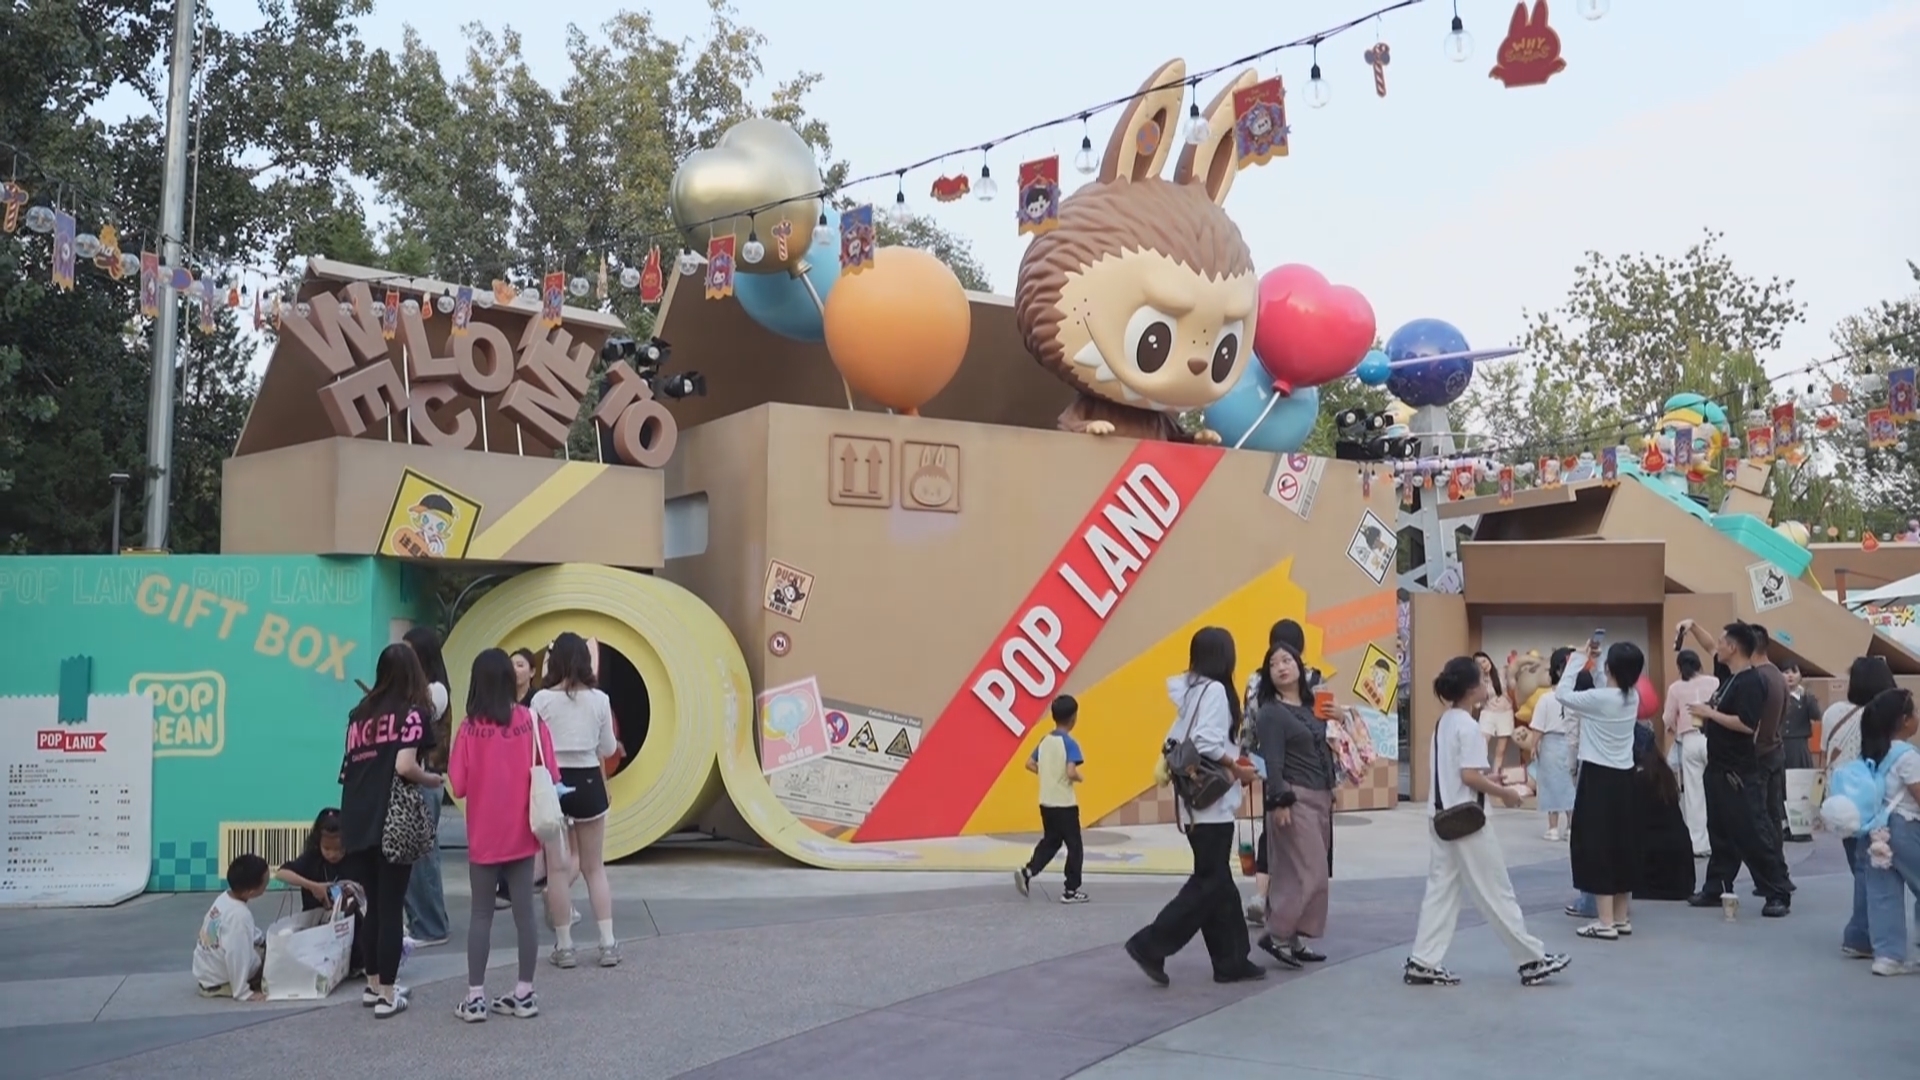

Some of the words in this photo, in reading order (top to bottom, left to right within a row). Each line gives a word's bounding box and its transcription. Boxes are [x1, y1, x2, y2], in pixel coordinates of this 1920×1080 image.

[593, 359, 678, 468] TO
[135, 573, 249, 640] GIFT
[254, 613, 357, 681] BOX
[971, 605, 1071, 738] POP
[1058, 462, 1180, 620] LAND
[40, 733, 62, 747] POP
[65, 735, 97, 750] LAND
[153, 713, 213, 745] EAN
